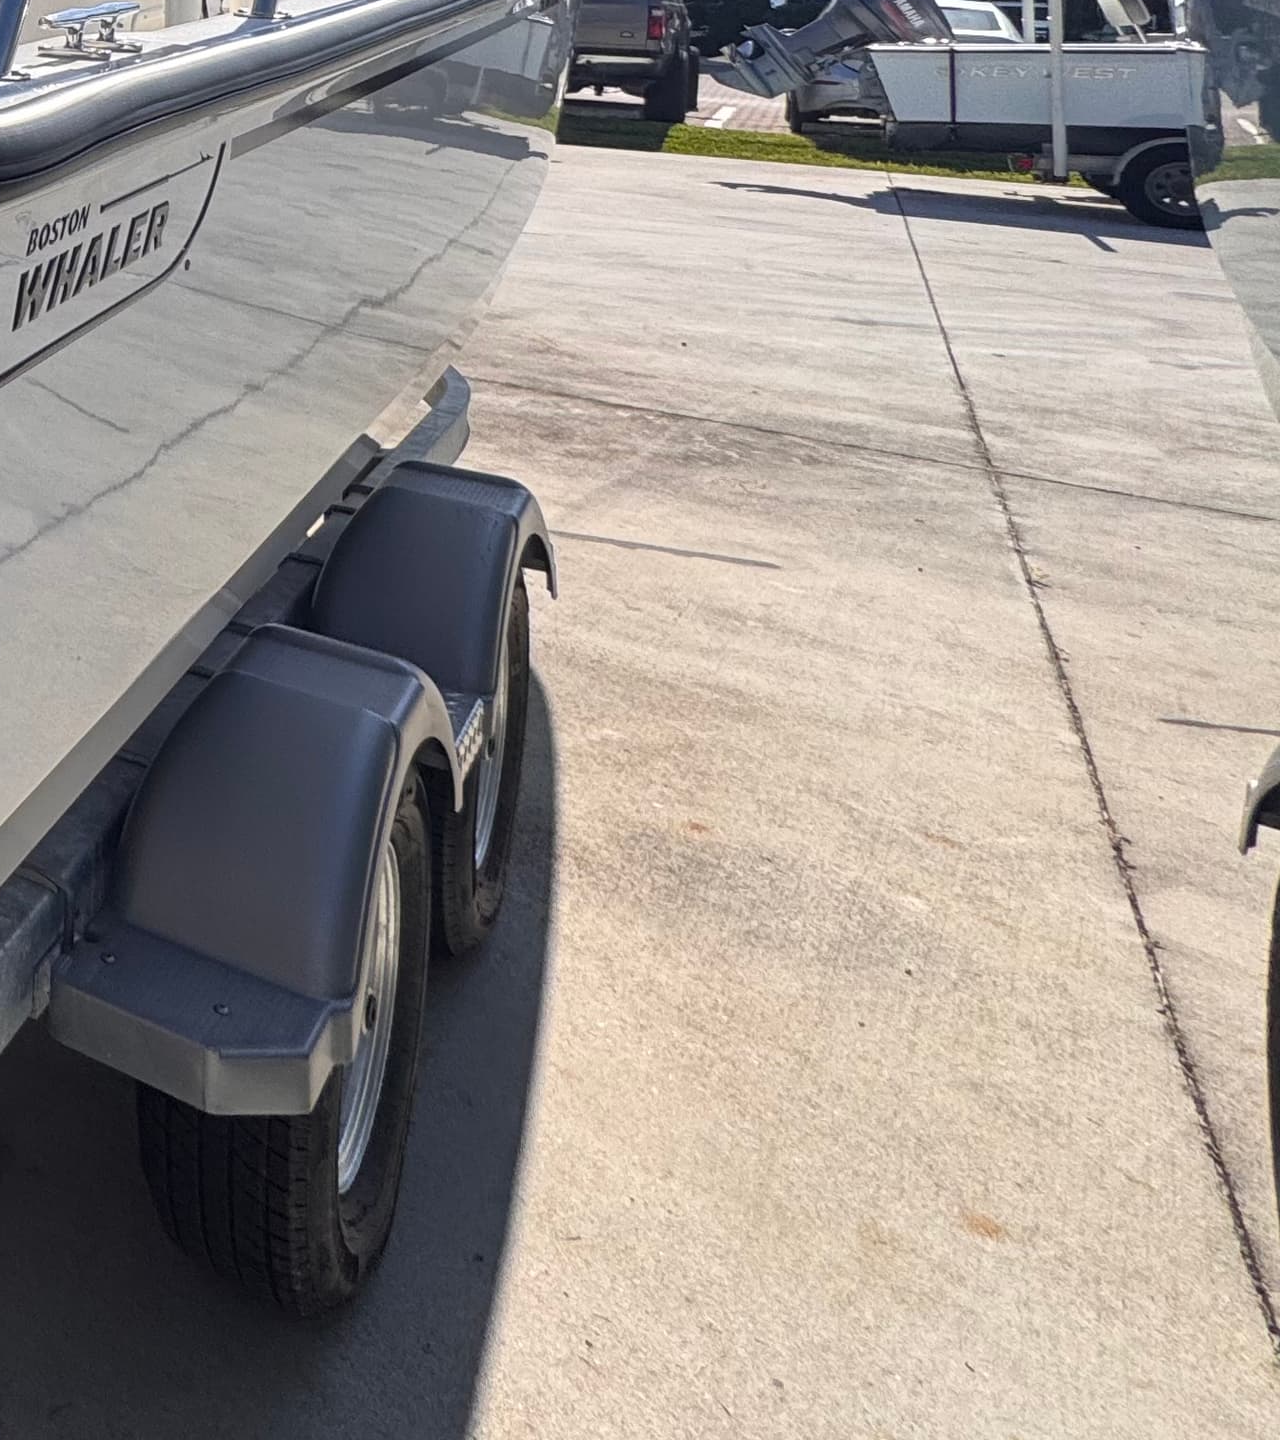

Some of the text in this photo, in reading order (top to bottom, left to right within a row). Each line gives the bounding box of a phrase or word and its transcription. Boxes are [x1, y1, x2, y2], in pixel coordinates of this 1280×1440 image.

[969, 65, 1033, 79] KEY
[26, 203, 91, 257] BOSTON
[11, 200, 170, 333] WHALER
